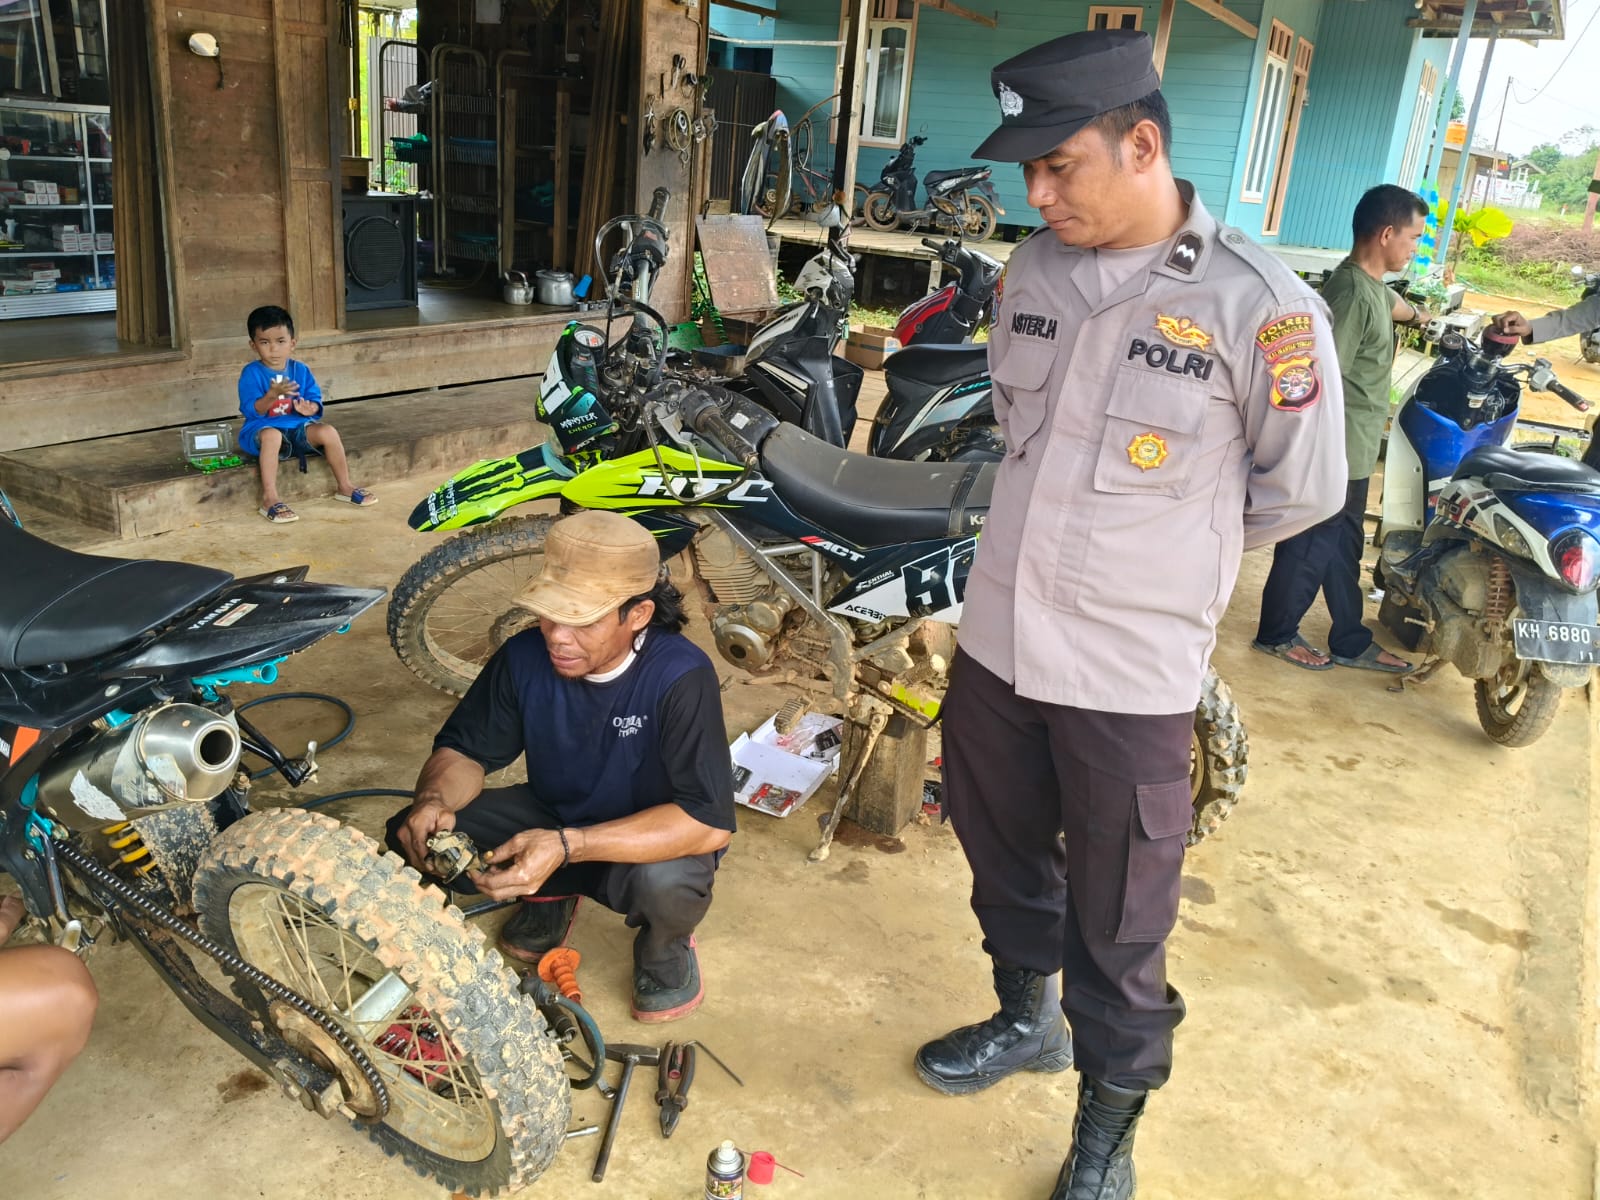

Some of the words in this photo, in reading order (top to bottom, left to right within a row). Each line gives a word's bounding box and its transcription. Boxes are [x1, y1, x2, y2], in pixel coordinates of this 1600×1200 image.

[1258, 316, 1310, 341] POLRES
[1127, 338, 1214, 381] POLRI
[559, 411, 599, 430] MONSTER
[568, 421, 598, 435] ENERGY
[187, 598, 242, 630] YAMAHA
[1518, 621, 1540, 639] KH
[1548, 625, 1590, 644] 6880
